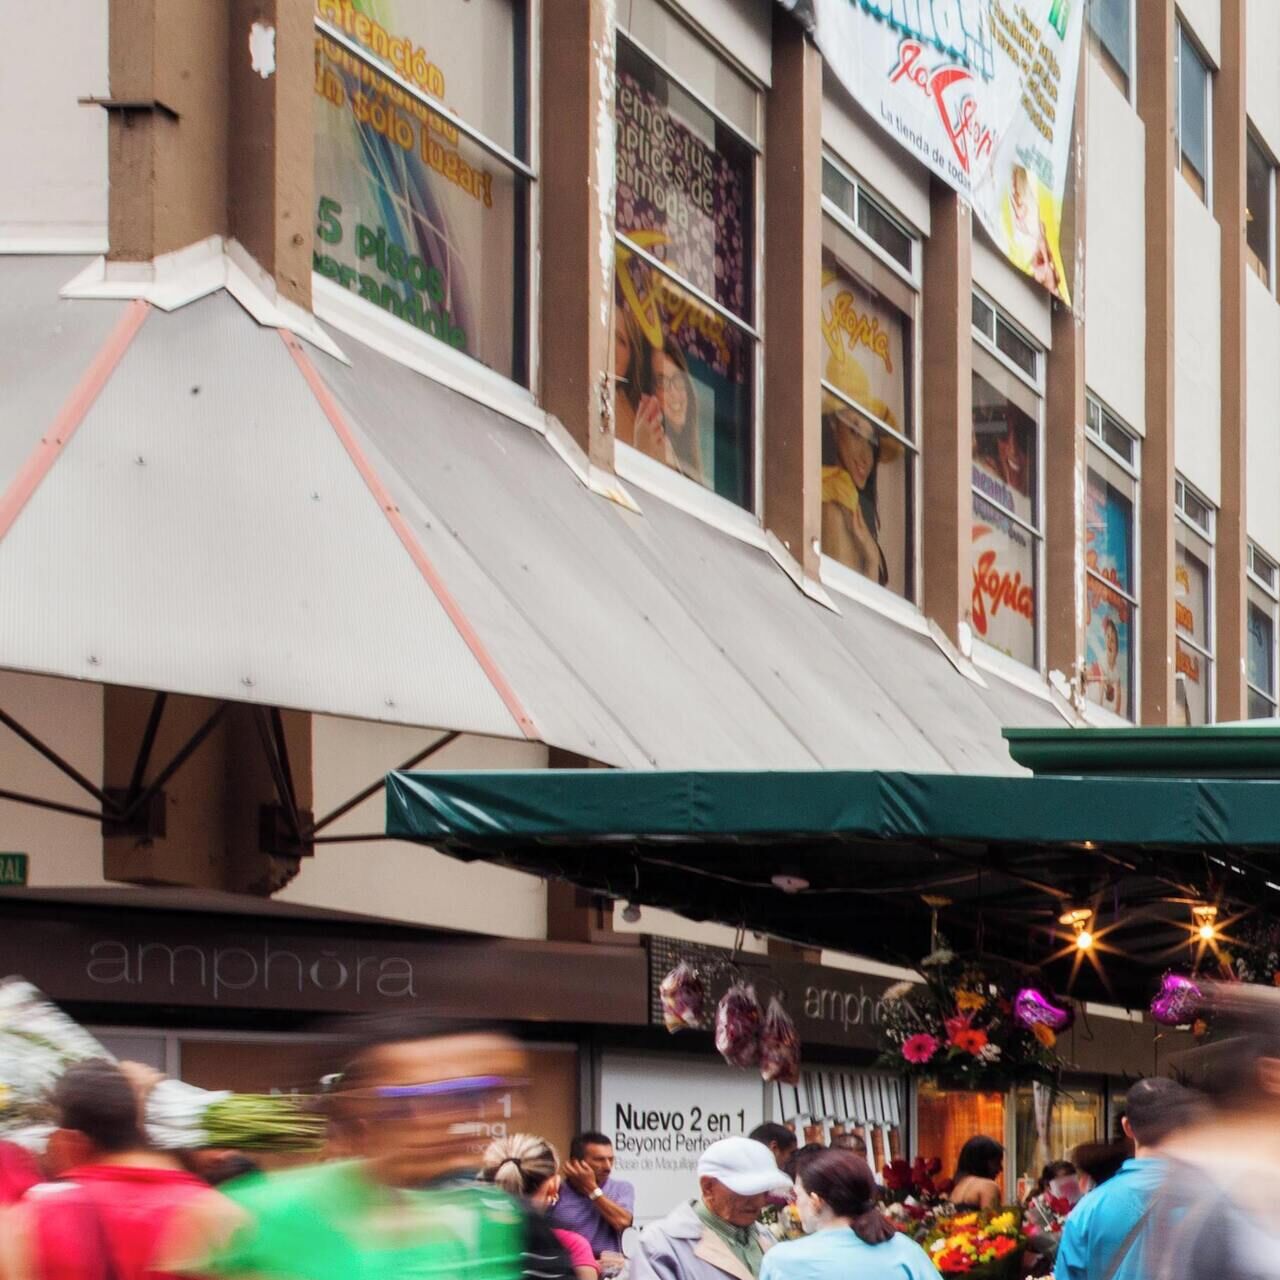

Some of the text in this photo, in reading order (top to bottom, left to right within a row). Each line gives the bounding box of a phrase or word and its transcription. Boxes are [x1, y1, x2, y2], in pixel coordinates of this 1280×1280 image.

[317, 0, 446, 99] Atención
[616, 80, 713, 180] emos tus
[880, 100, 893, 125] La
[896, 114, 930, 156] tienda
[932, 148, 945, 167] de
[634, 168, 690, 231] moda
[691, 176, 713, 214] de
[316, 195, 444, 304] 5 pisos
[615, 1132, 671, 1155] Beyond
[616, 1103, 745, 1133] Nuevo 2 en 1
